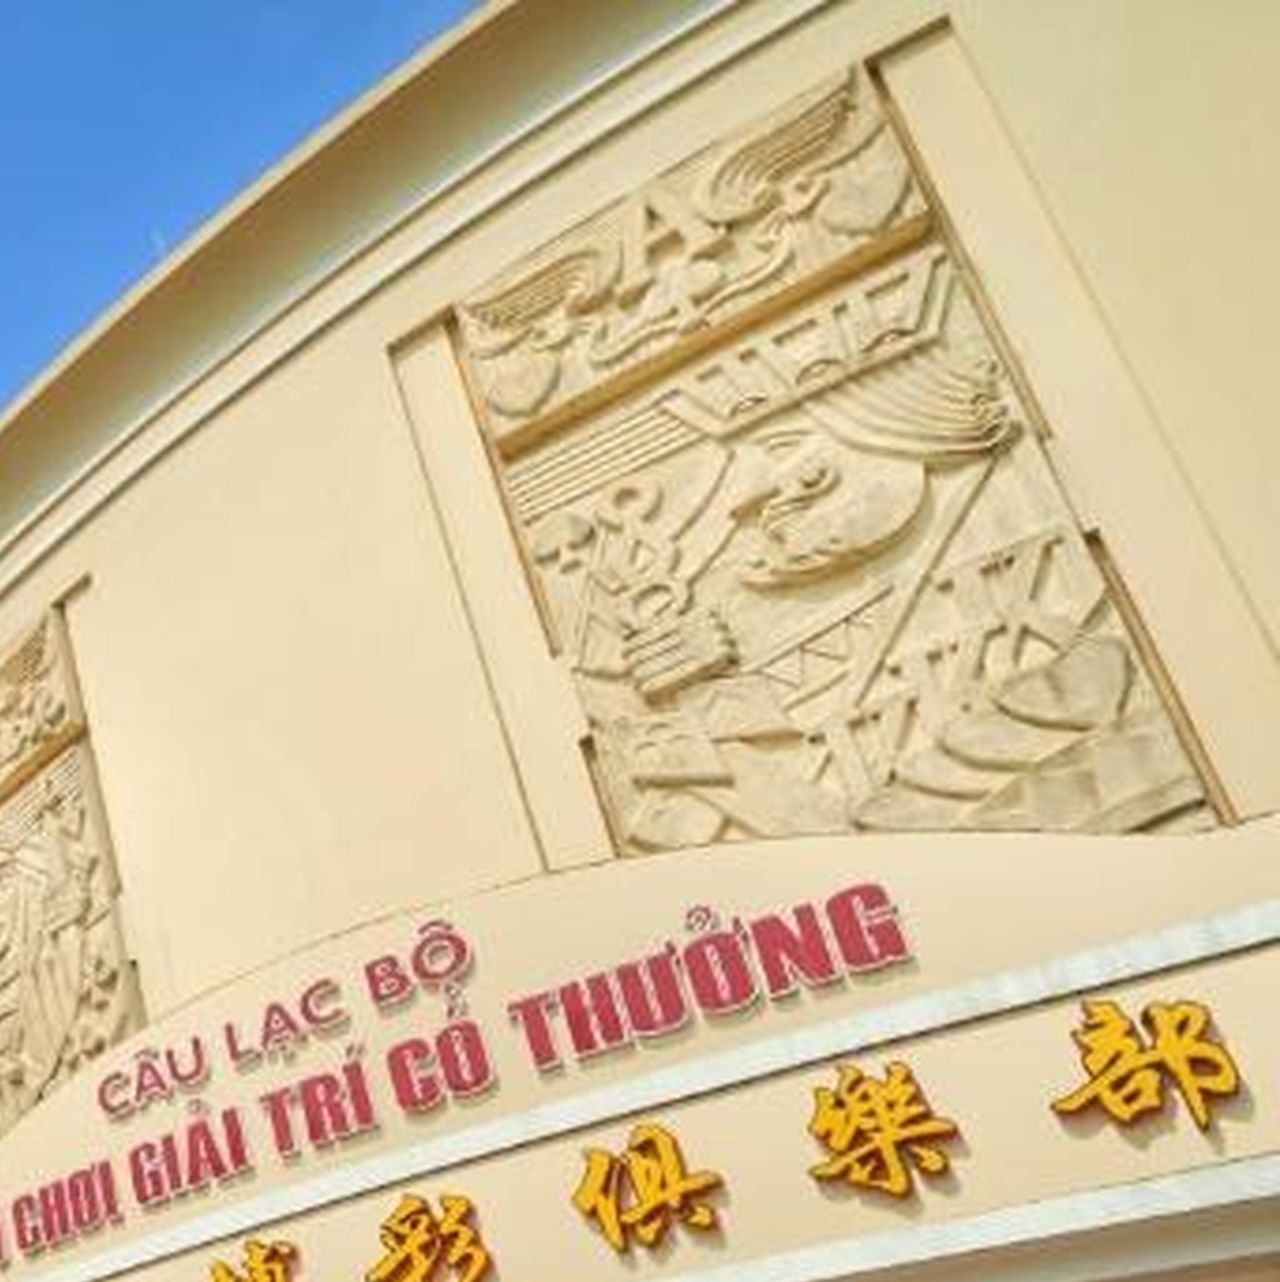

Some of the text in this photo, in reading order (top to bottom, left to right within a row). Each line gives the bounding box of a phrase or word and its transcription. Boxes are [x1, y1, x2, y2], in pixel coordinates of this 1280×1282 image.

[12, 1160, 118, 1252] CHƠI
[129, 1098, 250, 1205] GIẢI
[260, 1043, 376, 1158] TRÍ
[386, 1000, 493, 1114] CÓ
[508, 882, 910, 1069] THƯỞNG
[97, 920, 468, 1115] CÂU LẠC BỘ
